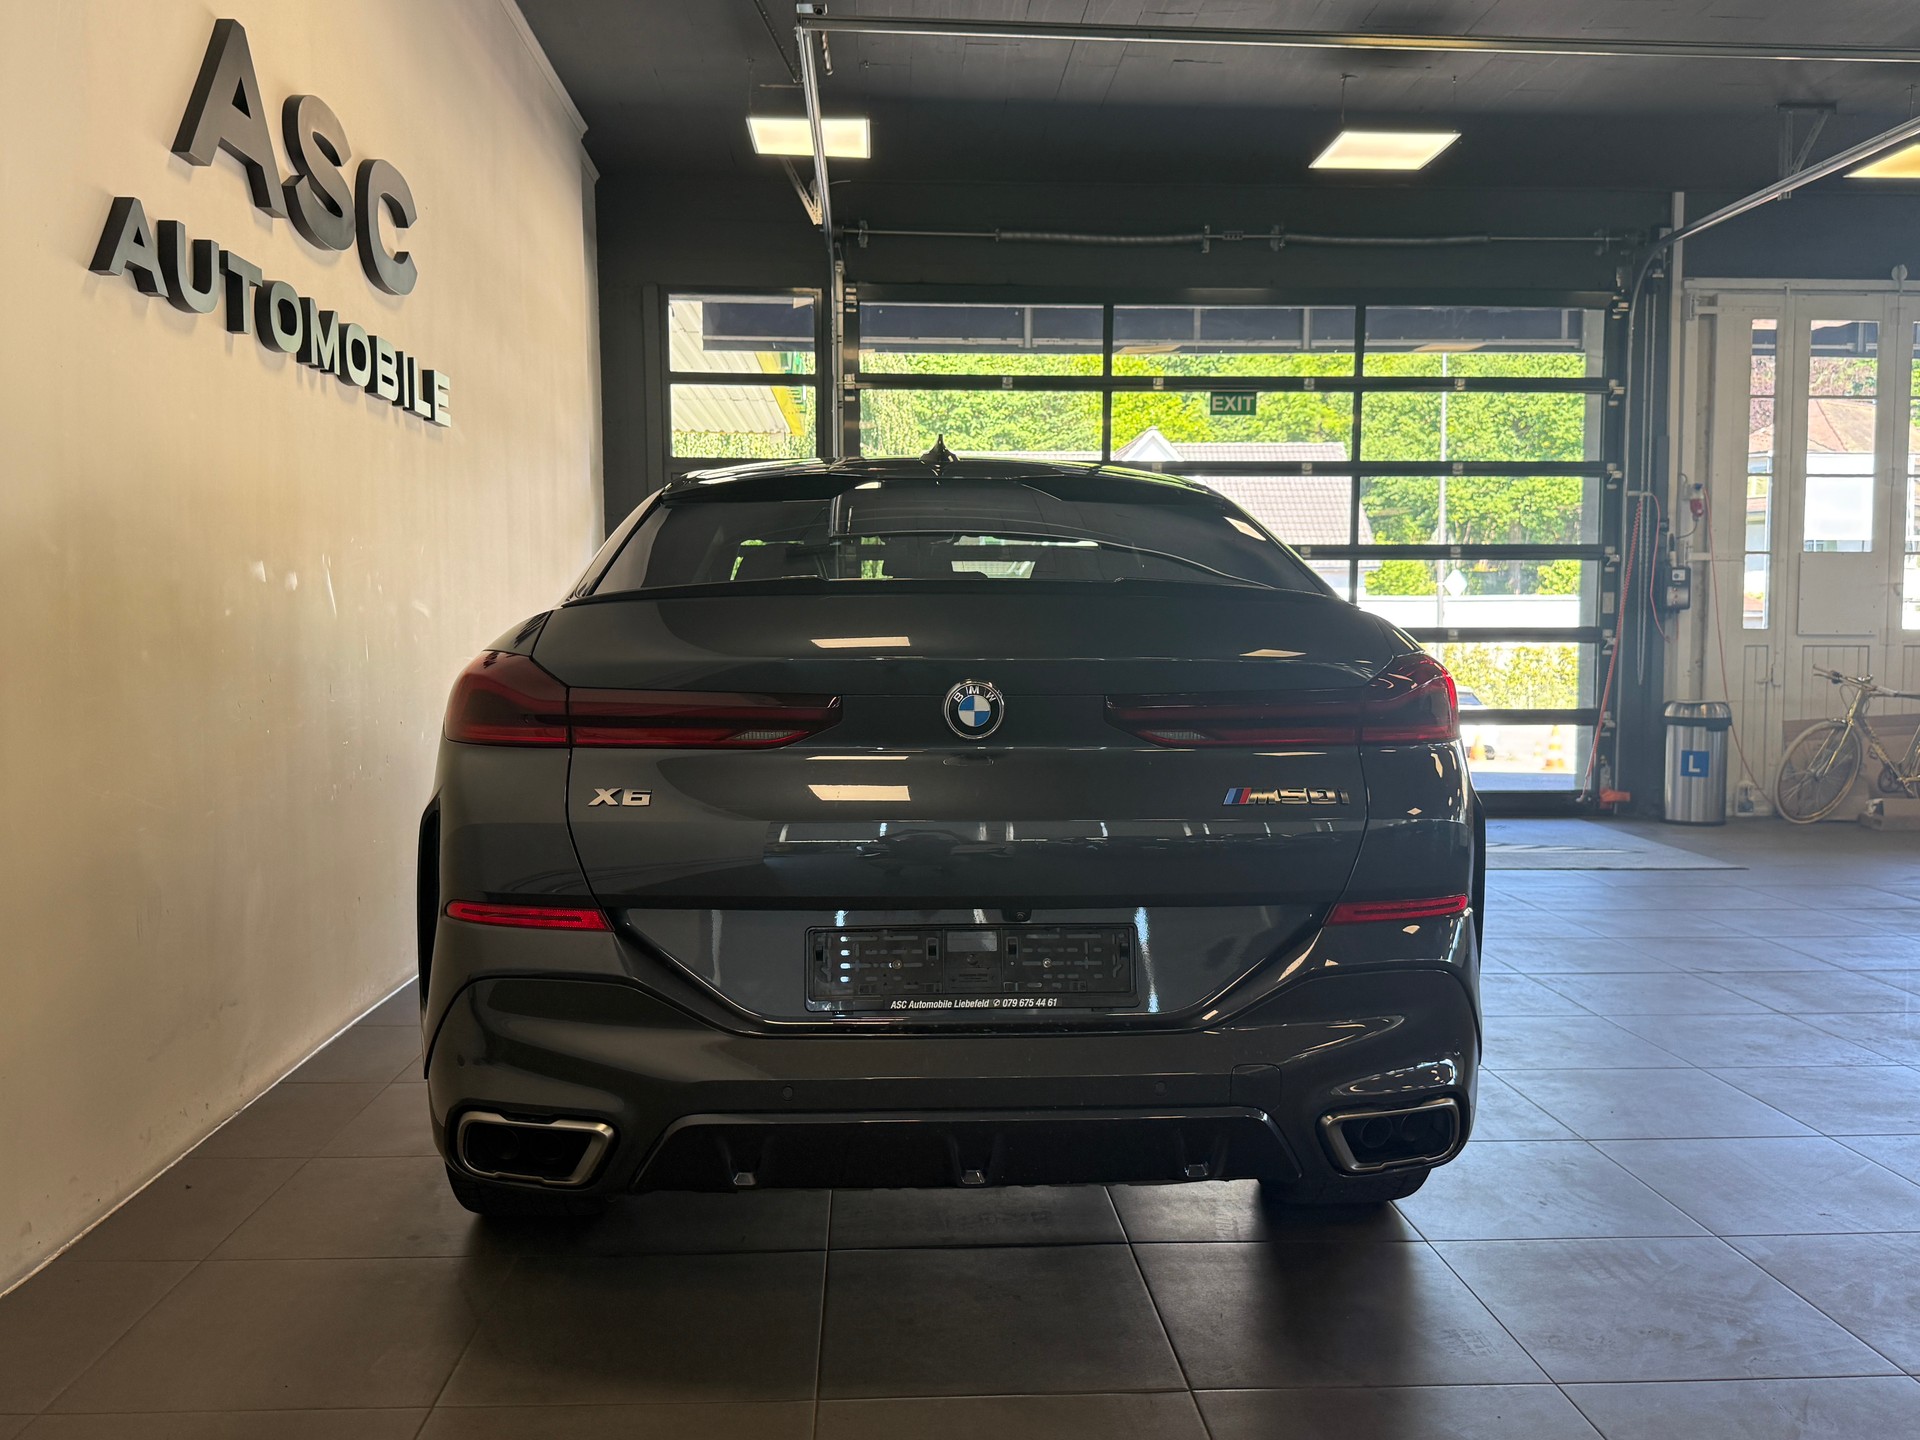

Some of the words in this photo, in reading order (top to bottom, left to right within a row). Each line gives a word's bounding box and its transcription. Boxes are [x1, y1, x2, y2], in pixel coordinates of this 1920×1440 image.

[171, 18, 418, 296] ASC
[88, 196, 452, 428] AUTOMOBILE
[1212, 395, 1255, 412] EXIT
[953, 685, 997, 703] BMW
[1688, 754, 1701, 773] L
[587, 787, 653, 807] X6
[890, 1000, 908, 1009] ASC
[908, 1000, 953, 1009] Automobile
[953, 999, 990, 1008] Liebefeld
[1002, 998, 1018, 1008] 079
[1018, 998, 1035, 1008] 675
[1035, 998, 1047, 1008] 44
[1047, 998, 1058, 1008] 61
